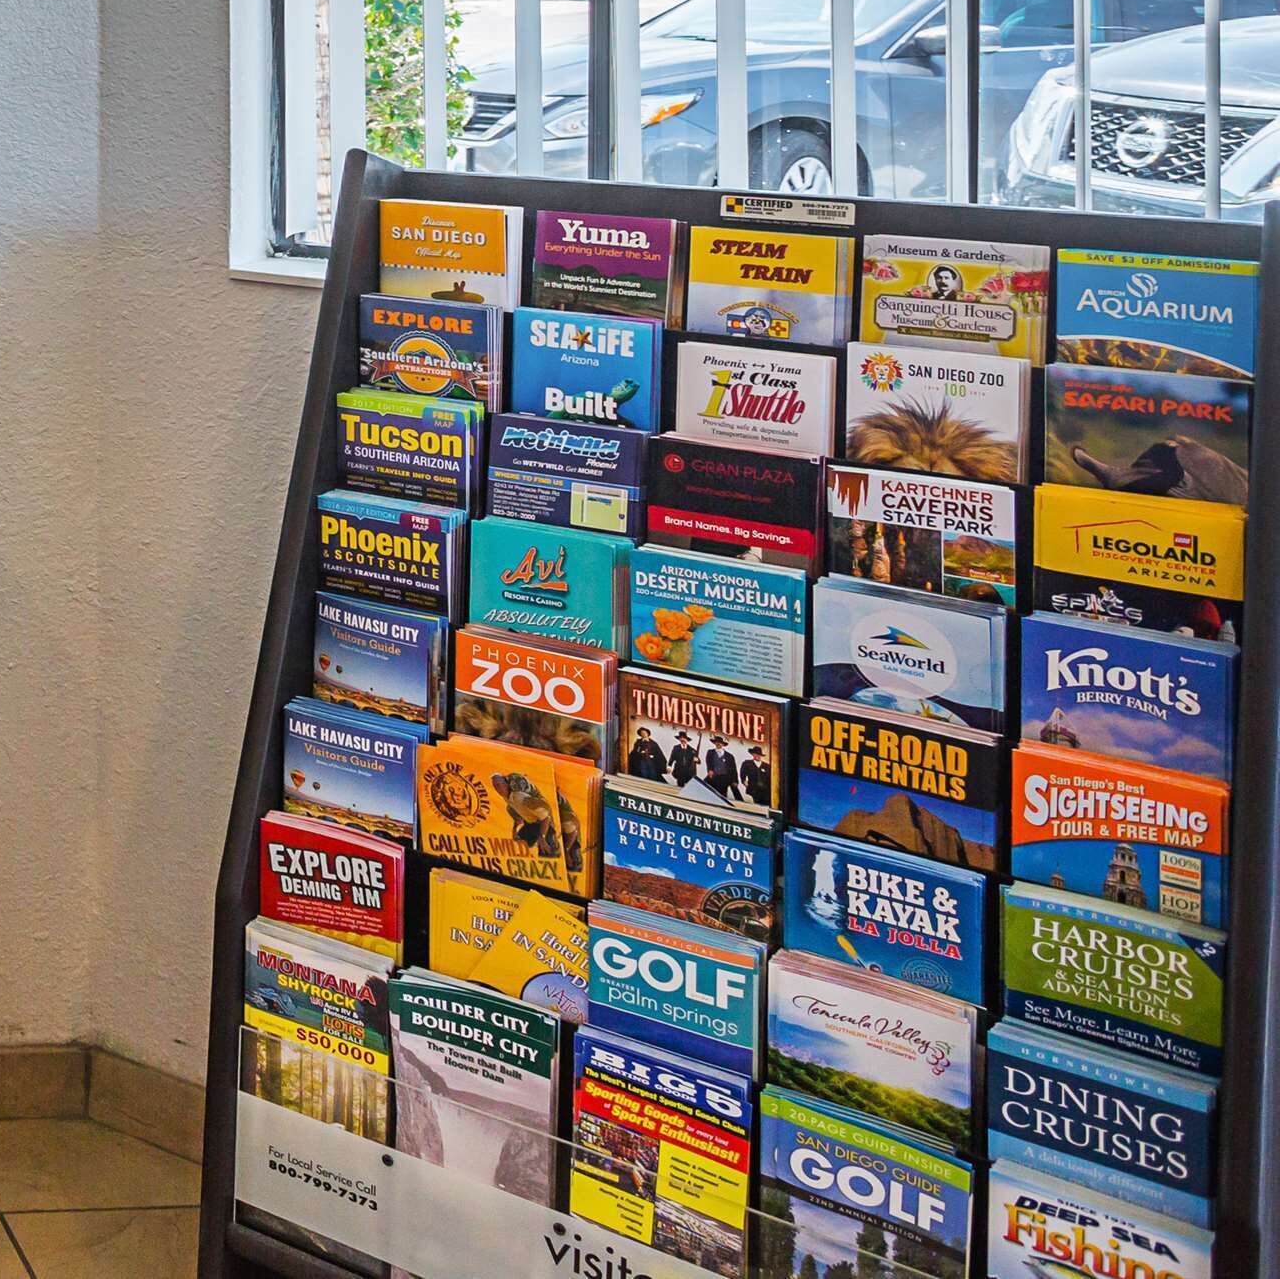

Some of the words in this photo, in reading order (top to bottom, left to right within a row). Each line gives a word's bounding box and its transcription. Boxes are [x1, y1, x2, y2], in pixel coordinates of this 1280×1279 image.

[745, 198, 793, 210] CERTIFIED
[392, 226, 426, 241] SAN
[432, 228, 487, 246] DIEGO
[545, 242, 592, 258] Everything
[594, 246, 624, 260] Under
[625, 250, 641, 261] the
[642, 252, 662, 263] Sun
[558, 218, 650, 250] Yuma
[710, 239, 788, 260] STEAM
[888, 243, 938, 258] Museum
[941, 246, 952, 260] &
[954, 248, 1007, 264] Gardens
[1086, 252, 1115, 264] SAVE
[1122, 254, 1134, 264] $3
[1141, 255, 1163, 266] OFF
[1167, 257, 1231, 271] ADMISSION
[740, 264, 814, 285] TRAIN
[1098, 289, 1125, 297] BIRCH
[372, 308, 474, 335] EXPLORE
[1077, 288, 1234, 324] AQUARIUM
[364, 347, 420, 365] Southern
[424, 357, 484, 374] Arizona's
[394, 363, 452, 377] ATTRACTIONS
[560, 353, 600, 367] Arizona
[703, 355, 748, 369] Phoenix
[770, 363, 802, 376] Yuma
[908, 363, 932, 379] SAN
[938, 367, 975, 384] DIEGO
[979, 372, 1004, 387] ZOO
[545, 387, 618, 421] Built
[722, 383, 806, 425] Shuttle
[1064, 389, 1155, 414] SAFARI
[1161, 398, 1233, 424] PARK
[339, 413, 463, 458] Tucson
[344, 444, 352, 455] &
[354, 446, 410, 465] SOUTHERN
[412, 455, 460, 473] ARIZONA
[880, 479, 994, 507] KARTCHNER
[881, 493, 995, 523] CAVERNS
[411, 515, 430, 525] FREE
[664, 515, 693, 528] Brand
[695, 520, 733, 535] Names.
[734, 526, 749, 539] Big
[752, 530, 794, 545] Savings.
[882, 509, 935, 529] STATE
[943, 517, 994, 537] PARK
[321, 514, 441, 567] Phoenix
[1092, 534, 1217, 567] LEGOLAND
[660, 564, 760, 590] ARIZONA-SONORA
[1092, 549, 1161, 567] DISCOVERY
[1166, 561, 1217, 577] CENTER
[1127, 565, 1217, 588] ARIZONA
[635, 571, 699, 596] DESERT
[704, 583, 788, 612] MUSEUM
[635, 587, 651, 597] ZOO
[654, 591, 680, 602] GARDEN
[685, 596, 713, 608] MUSEUM
[717, 602, 746, 613] GALLERY
[751, 607, 788, 620] AQUARIUM
[318, 603, 342, 624] LAKE
[343, 610, 388, 636] HAVASU
[391, 624, 420, 644] CITY
[472, 643, 586, 681] PHOENIX
[857, 643, 947, 675] SeaWorld
[882, 664, 898, 675] SAN
[899, 667, 926, 678] DIEGO
[470, 658, 586, 715] ZOO
[1044, 647, 1202, 716] Knott's
[632, 688, 766, 743] TOMBSTONE
[1076, 691, 1123, 707] BERRY
[1126, 696, 1170, 721] FARM
[288, 718, 318, 740] LAKE
[320, 726, 370, 752] HAVASU
[373, 740, 404, 761] CITY
[304, 742, 348, 764] Visitors
[349, 754, 386, 774] Guide
[809, 715, 969, 779] OFF-ROAD
[811, 746, 858, 777] ATV
[861, 755, 967, 803] RENTALS
[1050, 773, 1072, 786] San
[1073, 775, 1115, 793] Diego's
[1116, 780, 1147, 797] Best
[617, 794, 665, 819] TRAIN
[665, 808, 753, 840] ADVENTURE
[1052, 820, 1095, 838] TOUR
[1100, 824, 1112, 837] &
[1117, 823, 1159, 842] FREE
[1165, 828, 1205, 849] MAP
[617, 817, 677, 850] VERDE
[679, 834, 755, 867] CANYON
[619, 833, 754, 879] RAILROAD
[268, 843, 386, 890] EXPLORE
[280, 875, 343, 902] DEMING
[351, 885, 382, 909] NM
[847, 863, 926, 907] BIKE
[932, 886, 959, 916] &
[1161, 893, 1201, 912] HOP
[847, 890, 962, 944] KAYAK
[847, 917, 881, 938] LA
[887, 928, 963, 961] JOLLA
[1031, 916, 1193, 979] HARBOR
[256, 949, 377, 1008] MONTANA
[592, 937, 747, 1010] GOLF
[599, 976, 636, 992] GREATER
[1031, 942, 1195, 1001] CRUISES
[1054, 968, 1069, 981] &
[1074, 971, 1110, 991] SEA
[1118, 980, 1170, 1008] LION
[277, 972, 357, 1010] SHYROCK
[1043, 978, 1184, 1027] ADVENTURES
[322, 1014, 365, 1040] LOTS
[608, 984, 658, 1012] palm
[661, 1001, 739, 1037] springs
[792, 994, 873, 1030] Temecula
[873, 1017, 931, 1054] Valley
[295, 1027, 377, 1066] $50,000
[323, 1026, 341, 1038] FOR
[342, 1032, 364, 1046] SALE
[411, 1011, 494, 1047] BOULDER
[498, 1037, 539, 1063] CITY
[1024, 999, 1045, 1016] See
[1054, 1005, 1101, 1030] More.
[1104, 1020, 1150, 1043] Learn
[1154, 1033, 1202, 1061] More.
[426, 1040, 446, 1056] The
[447, 1045, 475, 1064] Town
[476, 1053, 497, 1071] that
[499, 1061, 523, 1081] Built
[444, 1055, 481, 1076] Hoover
[482, 1068, 506, 1085] Dam
[1002, 1064, 1186, 1144] DINING
[1000, 1100, 1190, 1180] CRUISES
[269, 1145, 286, 1161] For
[287, 1151, 314, 1172] Local
[316, 1164, 354, 1189] Service
[355, 1179, 378, 1198] Call
[795, 1131, 833, 1156] SAN
[834, 1142, 889, 1175] DIEGO
[891, 1166, 943, 1199] GUIDE
[268, 1159, 380, 1212] 800-799-7373
[789, 1147, 947, 1234] GOLF
[1002, 1202, 1186, 1279] Fishin
[1014, 1195, 1101, 1229] DEEP
[1111, 1225, 1182, 1265] SEA
[544, 1233, 653, 1279] visit
